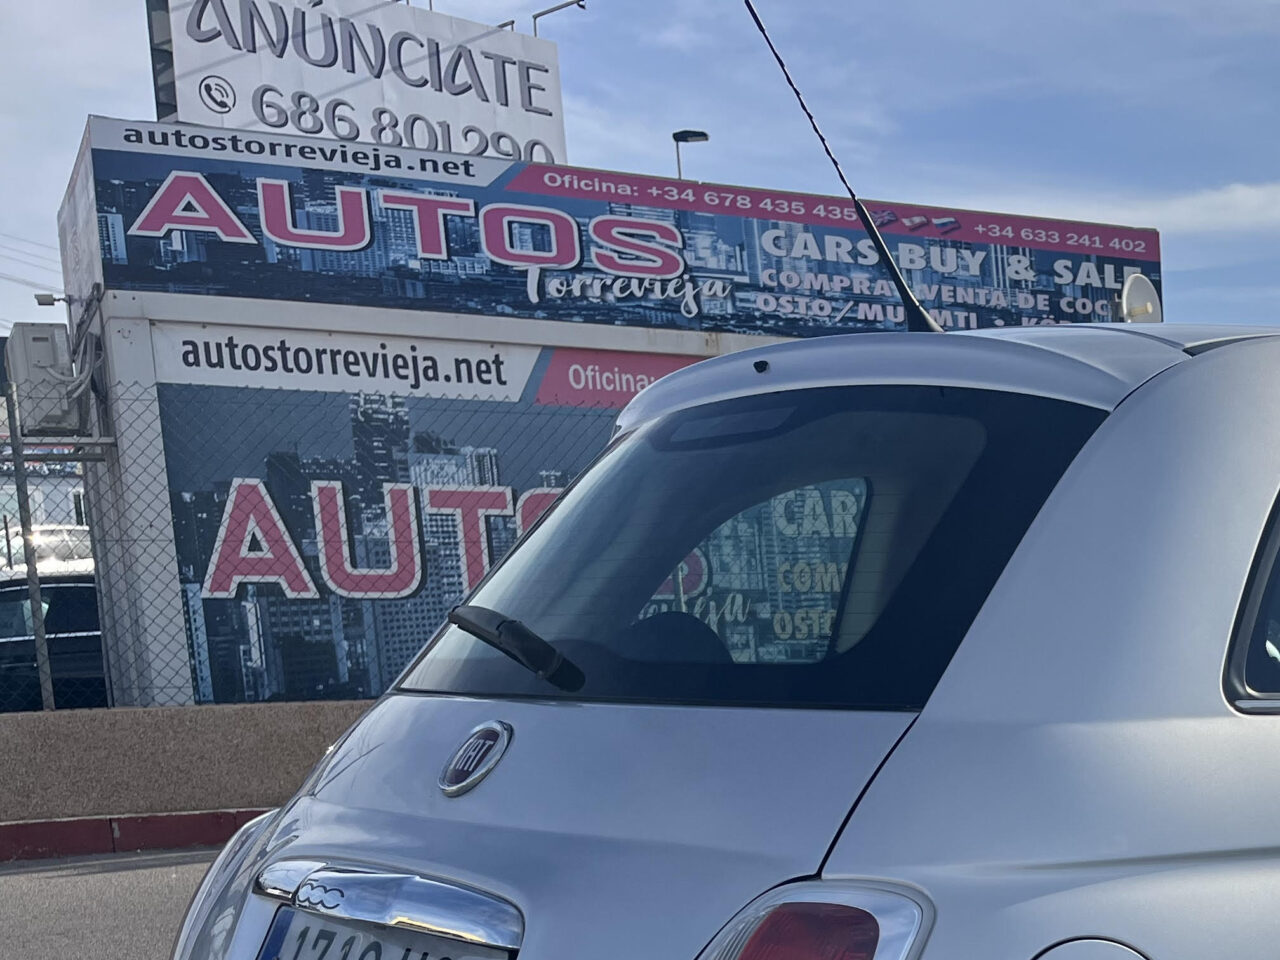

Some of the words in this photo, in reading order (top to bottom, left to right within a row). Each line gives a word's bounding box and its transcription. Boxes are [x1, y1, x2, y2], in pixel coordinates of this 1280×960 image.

[251, 84, 361, 142] 686
[123, 126, 476, 178] autostorrevieja.net
[543, 172, 639, 197] Oficina:
[647, 186, 696, 203] +34
[703, 191, 752, 209] 678
[758, 199, 806, 215] 435
[812, 204, 859, 221] 435
[126, 169, 686, 279] AUTOS
[973, 223, 1014, 239] +34
[1020, 228, 1060, 244] 633
[1065, 233, 1104, 249] 241
[1108, 237, 1147, 253] 402
[760, 228, 880, 267] CARS
[897, 242, 987, 277] BUY
[1006, 254, 1037, 281] &
[513, 262, 733, 319] Torrevieja
[761, 268, 893, 298] COMPRA
[919, 283, 1009, 310] VENTA
[1017, 292, 1050, 311] DE
[181, 336, 508, 389] autostorrevieja.net
